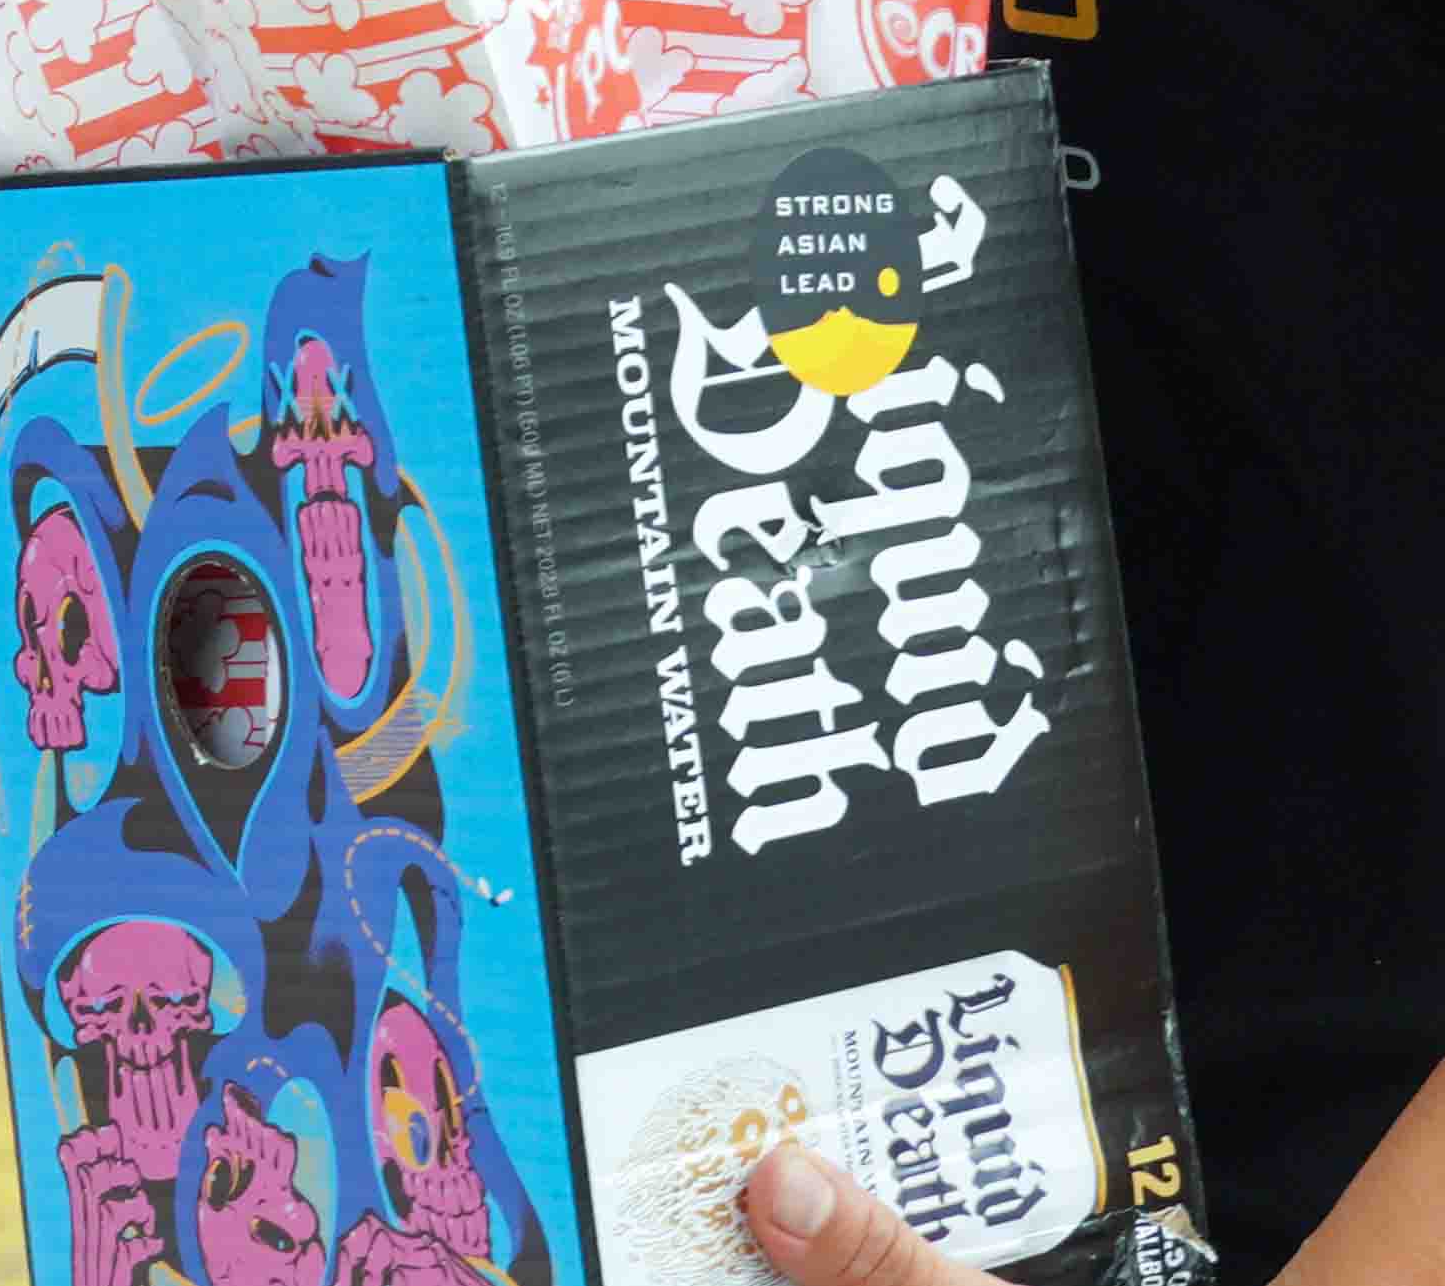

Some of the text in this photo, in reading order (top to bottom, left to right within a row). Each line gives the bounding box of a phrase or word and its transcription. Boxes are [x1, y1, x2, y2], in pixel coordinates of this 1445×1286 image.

[775, 193, 895, 217] STRONG
[777, 233, 868, 256] ASIAN
[780, 271, 856, 295] LEAD
[609, 295, 713, 867] MOUNTAIN WATER
[664, 282, 892, 856] Death
[942, 972, 1047, 1227] Liquid
[1126, 1134, 1182, 1206] 12
